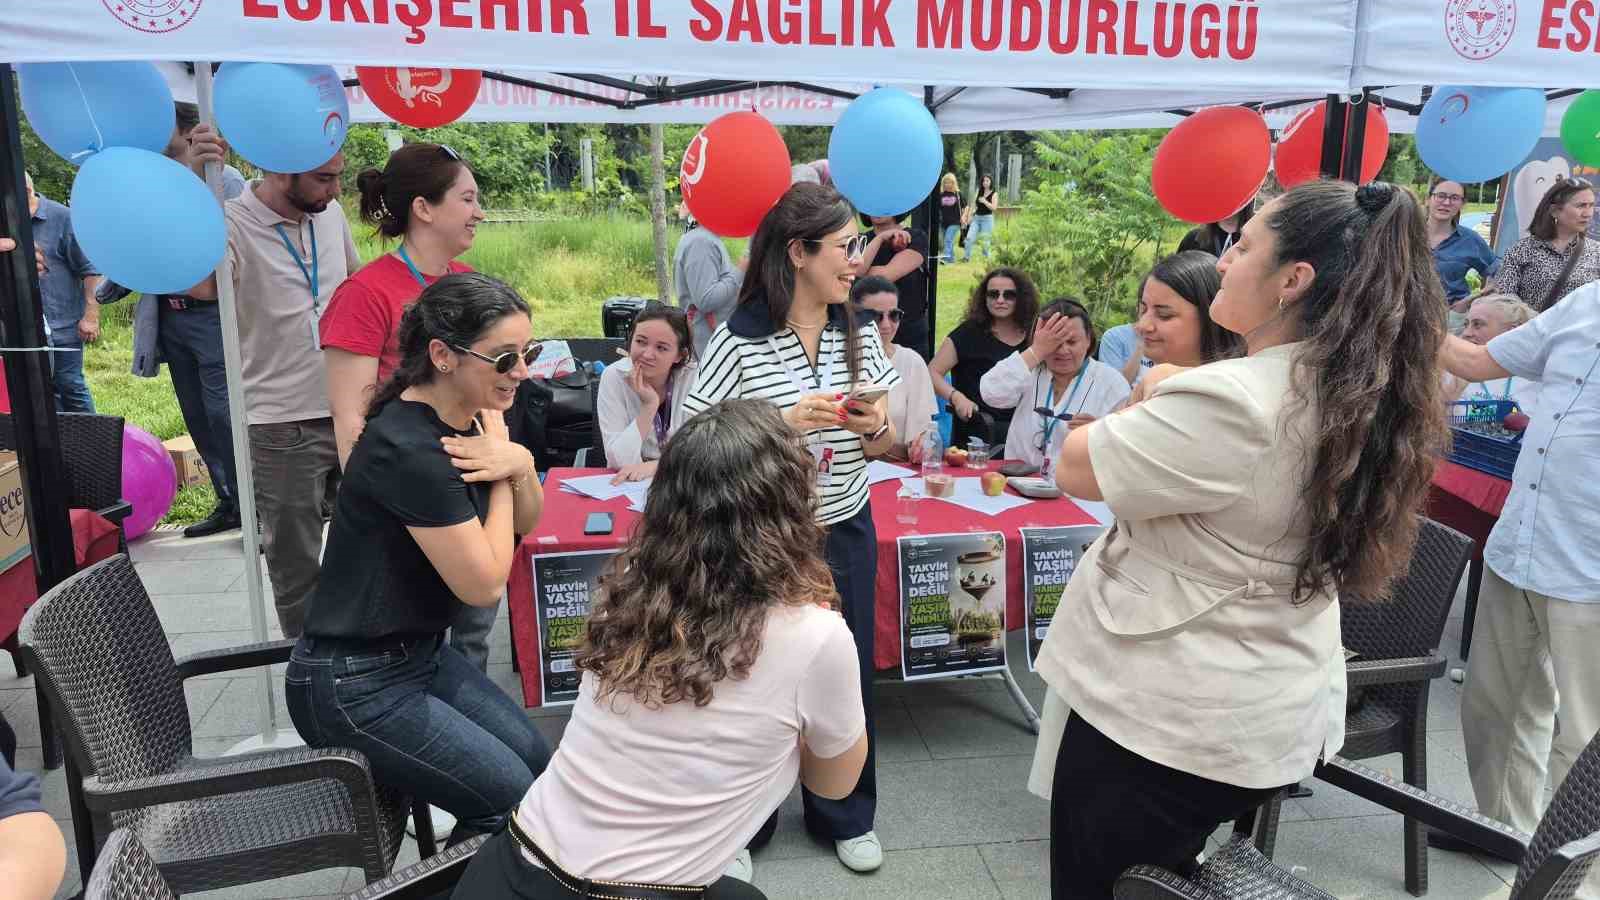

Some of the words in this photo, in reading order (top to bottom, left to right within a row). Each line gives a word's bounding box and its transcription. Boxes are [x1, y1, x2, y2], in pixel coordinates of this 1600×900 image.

[1537, 0, 1600, 54] ES
[1032, 549, 1073, 561] TAKVİM
[908, 561, 949, 573] TAKVİM
[1033, 559, 1074, 574] YAŞIN
[908, 571, 950, 585] YAŞIN
[544, 580, 588, 593] TAKVİM
[908, 582, 949, 598] DEĞİL
[546, 591, 590, 608] YAŞIN
[545, 603, 588, 619] DEĞİL
